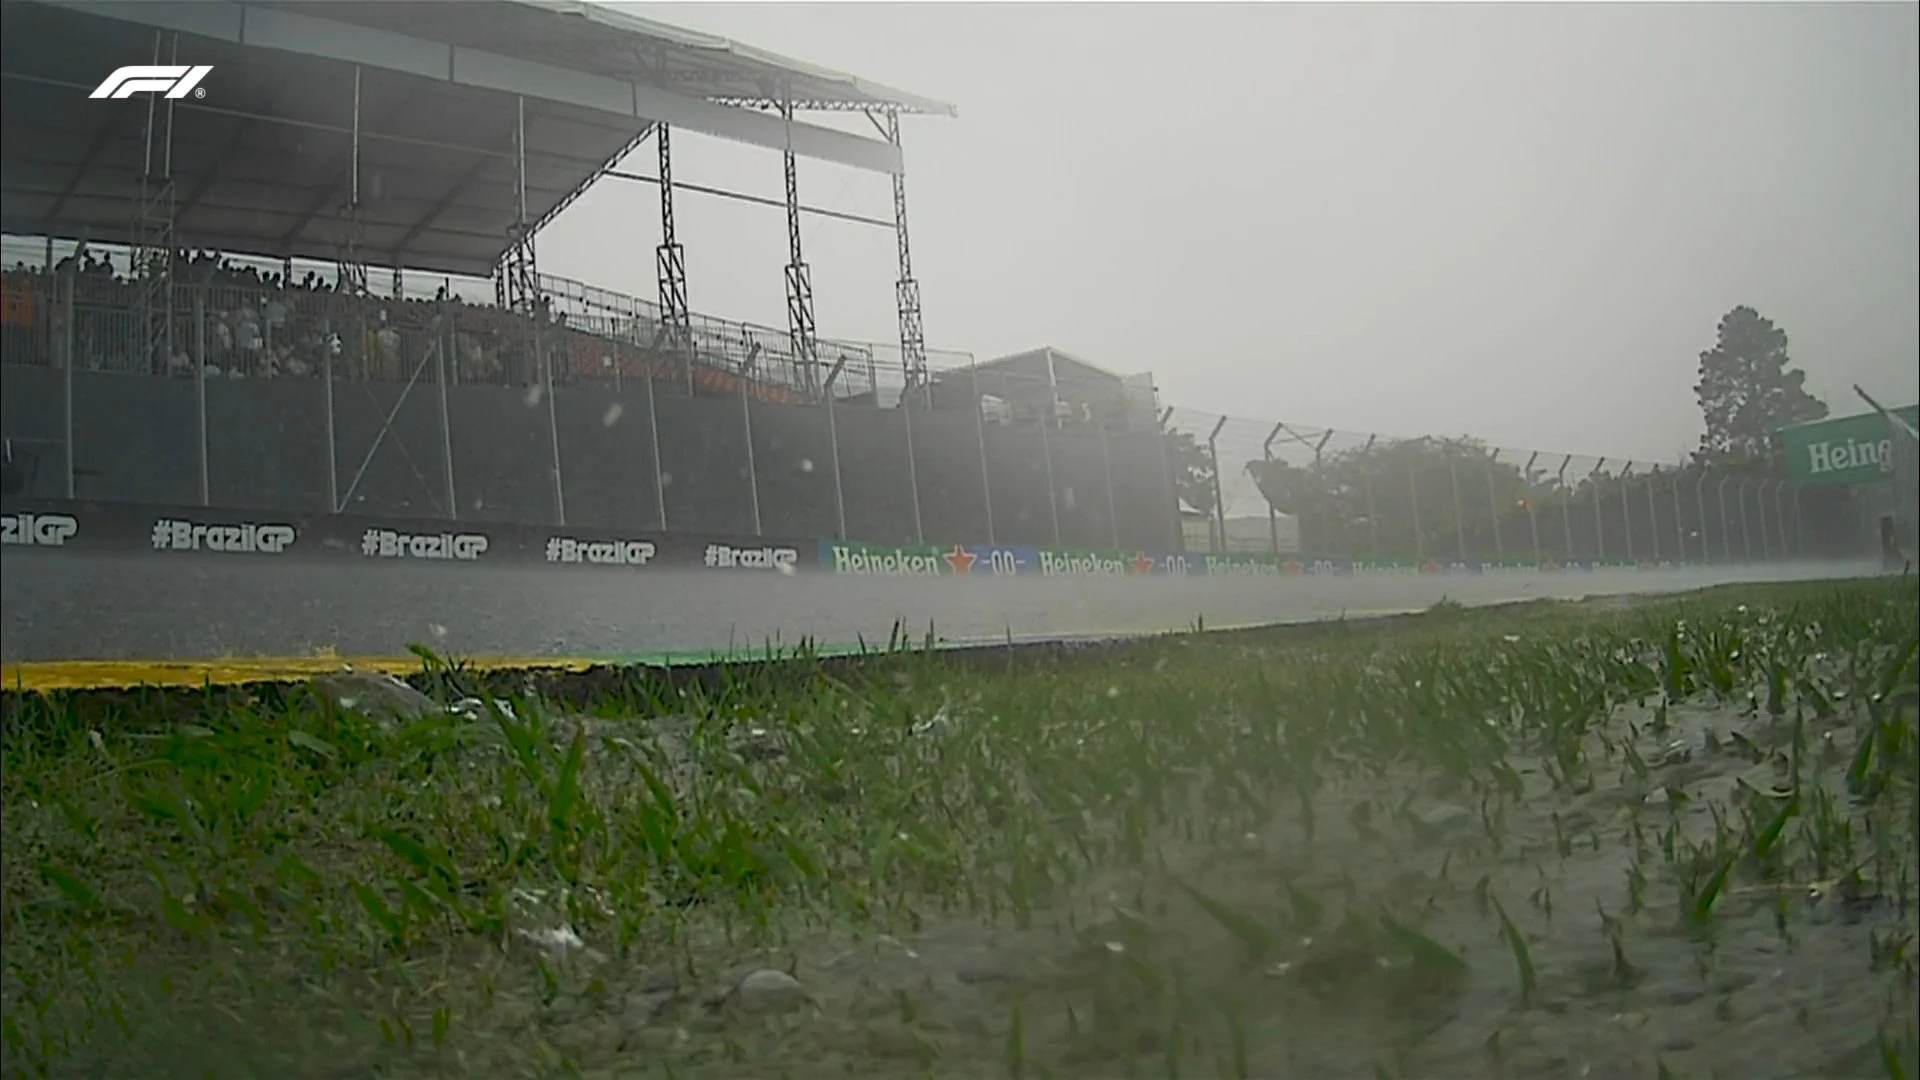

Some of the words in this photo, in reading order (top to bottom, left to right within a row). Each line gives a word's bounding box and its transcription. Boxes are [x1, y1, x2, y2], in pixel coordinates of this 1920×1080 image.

[151, 520, 295, 552] #BrazilGP
[361, 530, 488, 560] #BrazilGP
[546, 538, 655, 565] #BrazilGP
[704, 544, 797, 568] #BrazilGP
[832, 546, 939, 576] Heineken
[1039, 552, 1124, 577] Heineken
